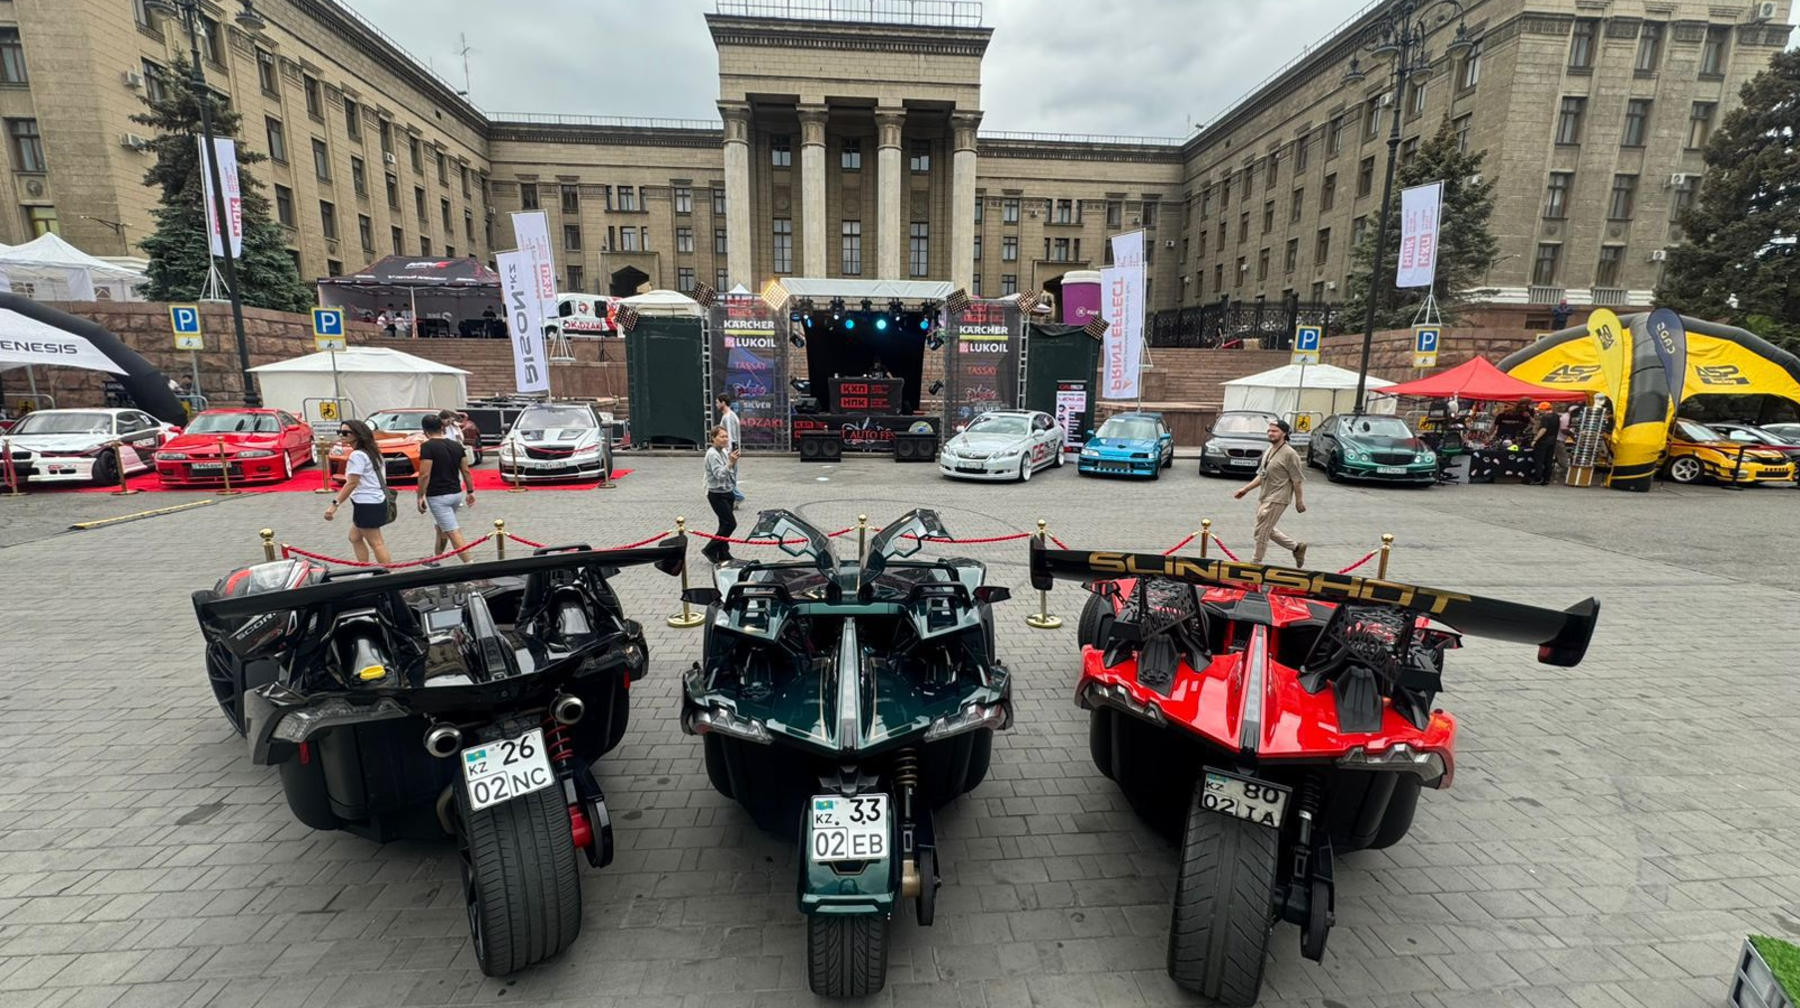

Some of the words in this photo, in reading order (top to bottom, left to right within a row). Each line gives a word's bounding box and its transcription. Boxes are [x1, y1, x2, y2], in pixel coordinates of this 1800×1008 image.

[178, 309, 193, 331] P
[321, 312, 337, 333] P
[0, 340, 78, 355] ENESIS
[736, 338, 776, 348] LUKOIL
[969, 343, 1008, 353] LUKOIL
[1302, 330, 1316, 348] P
[1422, 332, 1434, 350] P
[743, 401, 772, 409] SILVER
[1088, 551, 1472, 614] SLINGSHOT
[468, 761, 488, 777] KZ
[500, 735, 535, 766] 26
[474, 776, 509, 804] 02
[512, 767, 547, 793] NC
[1206, 781, 1224, 791] KZ
[1244, 783, 1279, 804] 80
[816, 813, 832, 824] KZ
[849, 798, 881, 823] 33
[1204, 794, 1236, 815] 02
[816, 831, 845, 856] 02
[853, 833, 883, 855] EB
